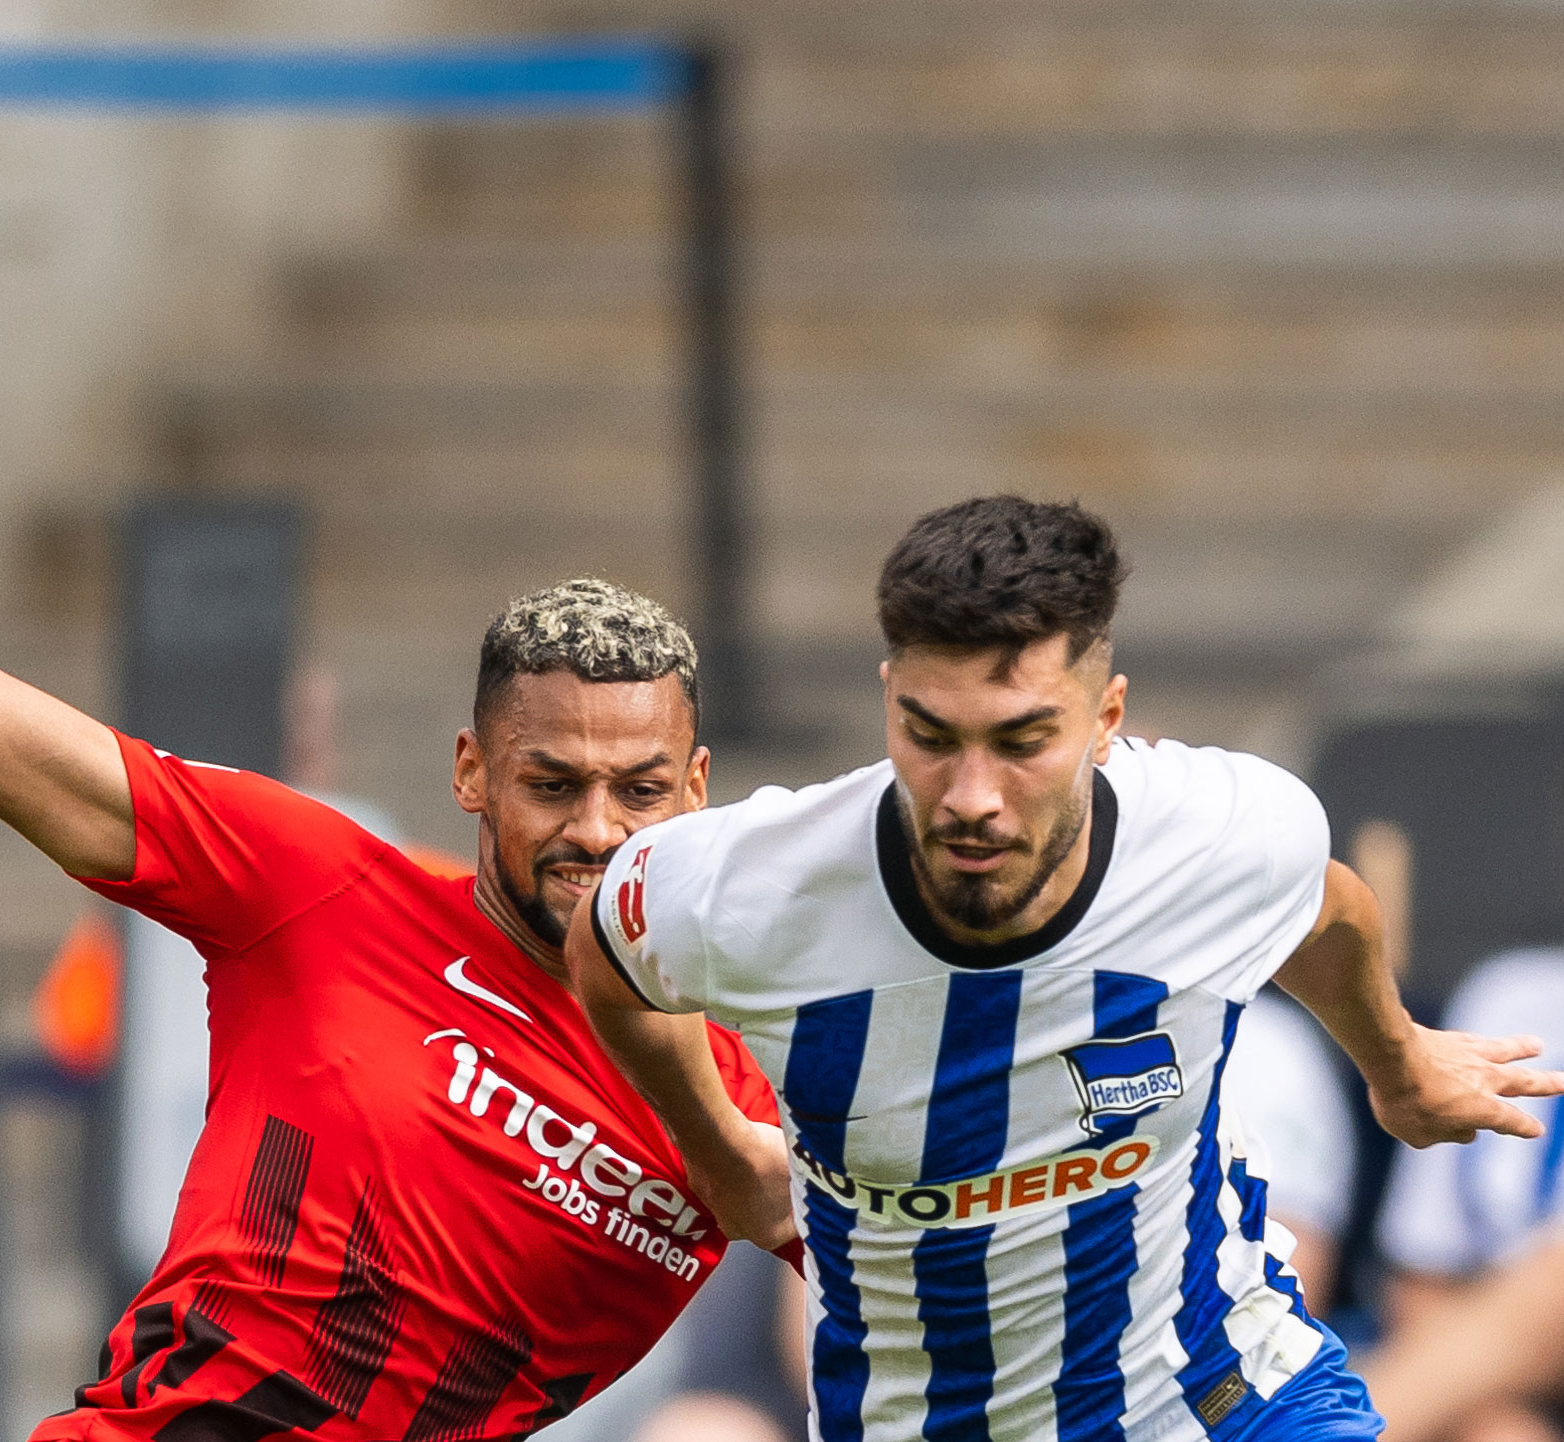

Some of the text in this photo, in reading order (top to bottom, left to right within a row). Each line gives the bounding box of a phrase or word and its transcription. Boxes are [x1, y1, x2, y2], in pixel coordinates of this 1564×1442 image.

[521, 1163, 701, 1282] Jobs finden
[791, 1140, 1151, 1222] AUTOHERO
